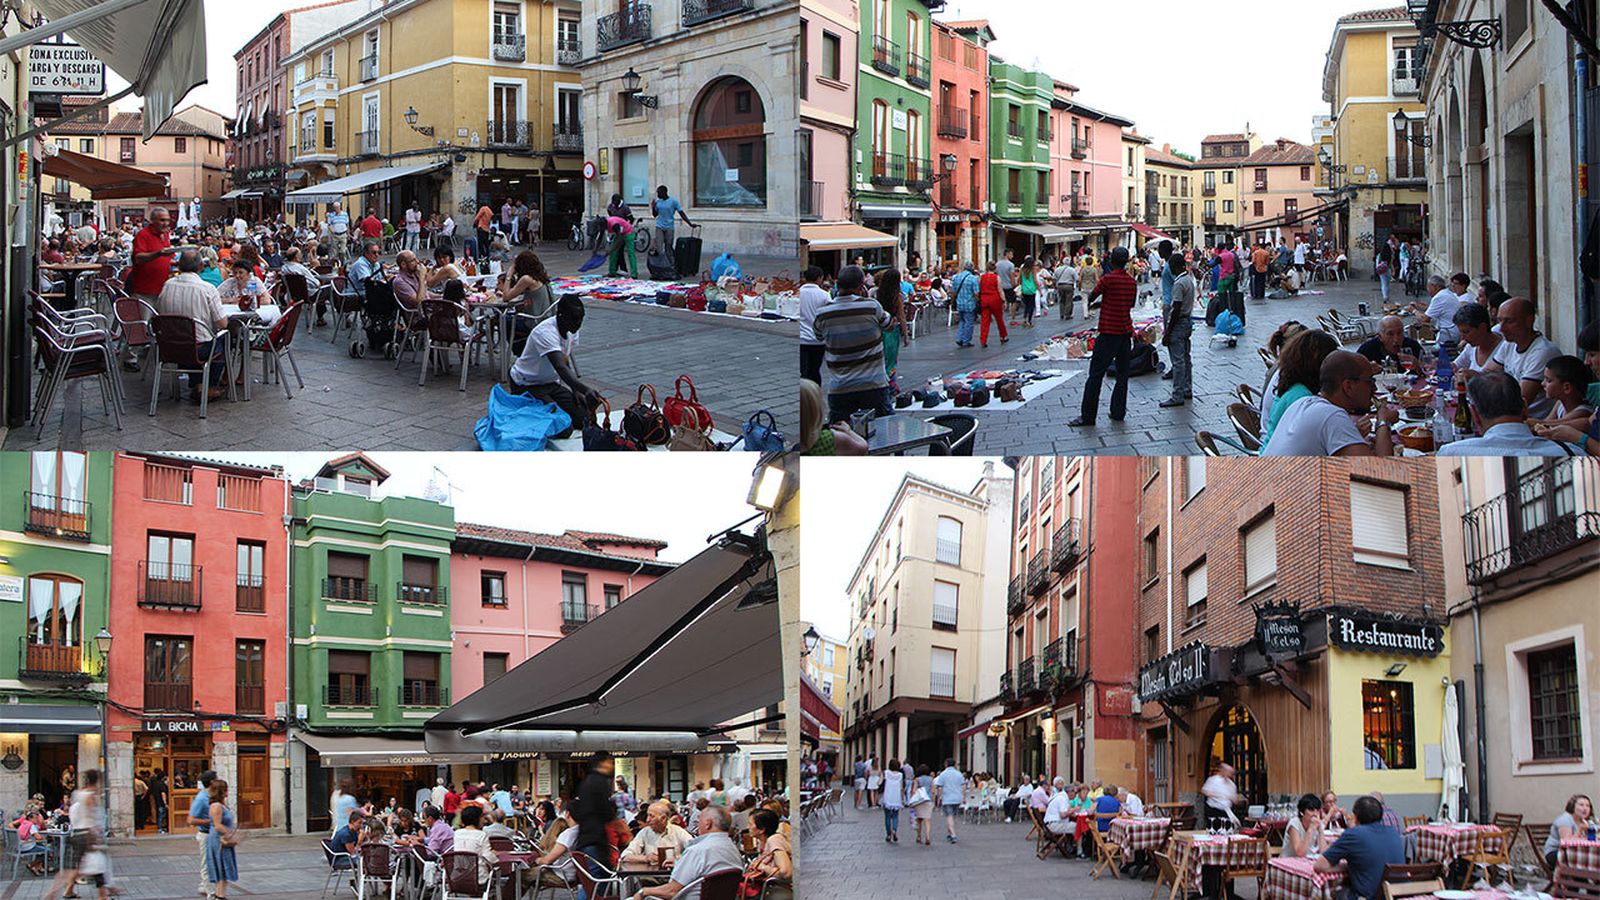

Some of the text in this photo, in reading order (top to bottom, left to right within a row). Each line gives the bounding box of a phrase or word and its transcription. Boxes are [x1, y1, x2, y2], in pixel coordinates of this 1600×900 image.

[30, 50, 98, 60] ZONA EXCLUSIV
[53, 63, 60, 73] Y
[63, 63, 101, 74] DESCARGA
[32, 76, 47, 86] DE
[89, 77, 96, 86] H
[1340, 618, 1435, 650] Restaurante
[1141, 670, 1167, 697] Mesón
[146, 721, 199, 732] LA BICHA
